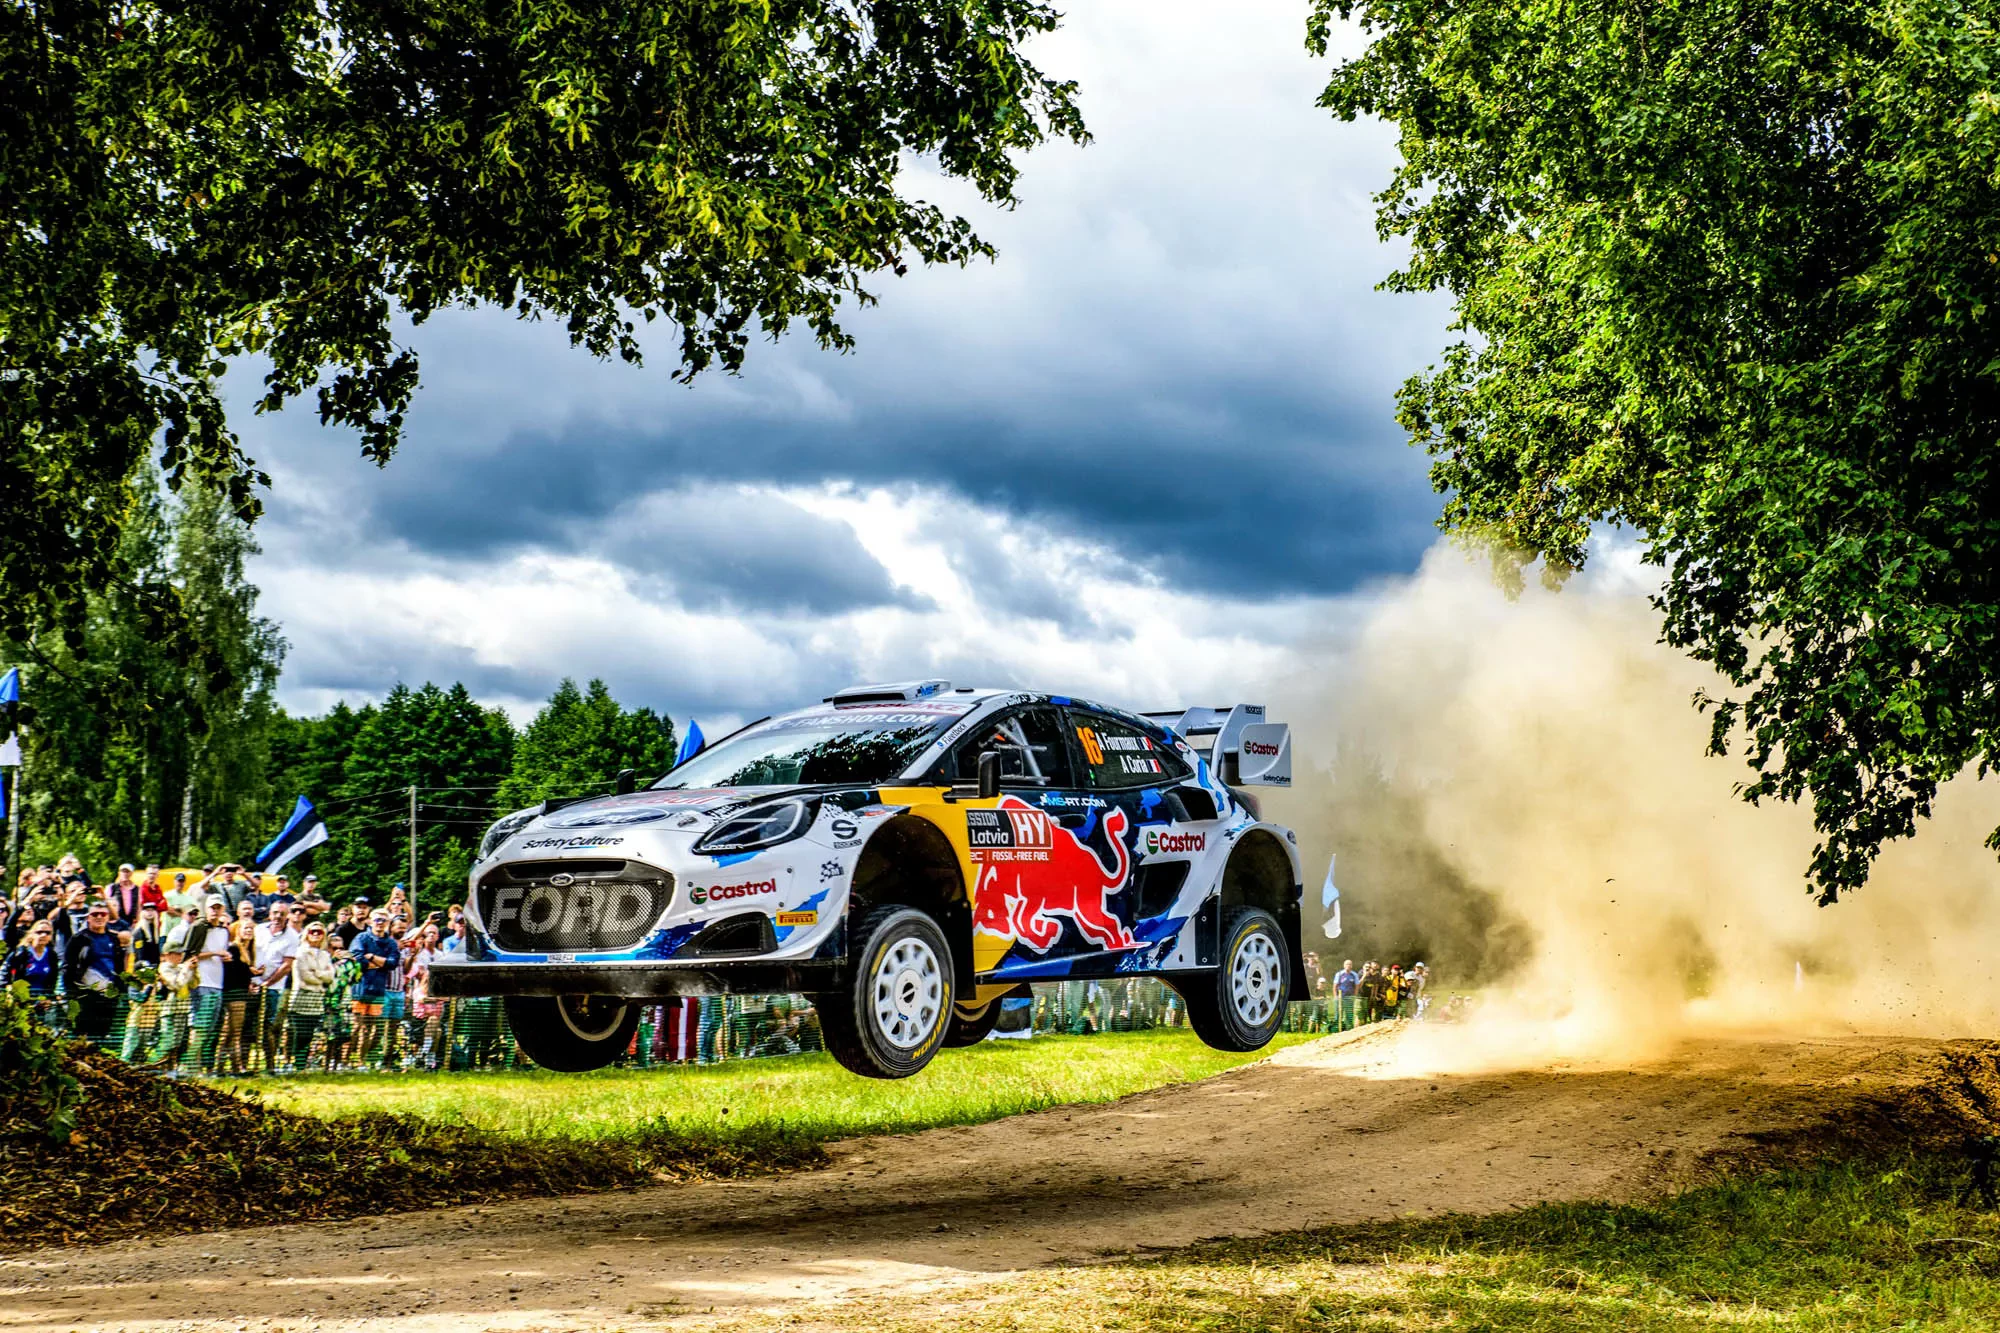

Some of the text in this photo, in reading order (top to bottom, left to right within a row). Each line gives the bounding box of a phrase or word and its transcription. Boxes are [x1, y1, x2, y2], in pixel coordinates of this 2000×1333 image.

[1077, 727, 1104, 765] 16
[1095, 732, 1106, 750] A
[1251, 742, 1279, 756] Castrol
[1120, 755, 1130, 773] A
[972, 828, 1009, 845] Latvia
[1012, 813, 1045, 844] HY
[522, 836, 624, 849] SafetyCulture
[1159, 832, 1205, 852] Castrol
[992, 851, 1049, 861] FOSSIL-FREE FUEL
[709, 879, 776, 901] Castrol
[488, 885, 653, 934] FORD
[779, 913, 814, 924] PIRELLI
